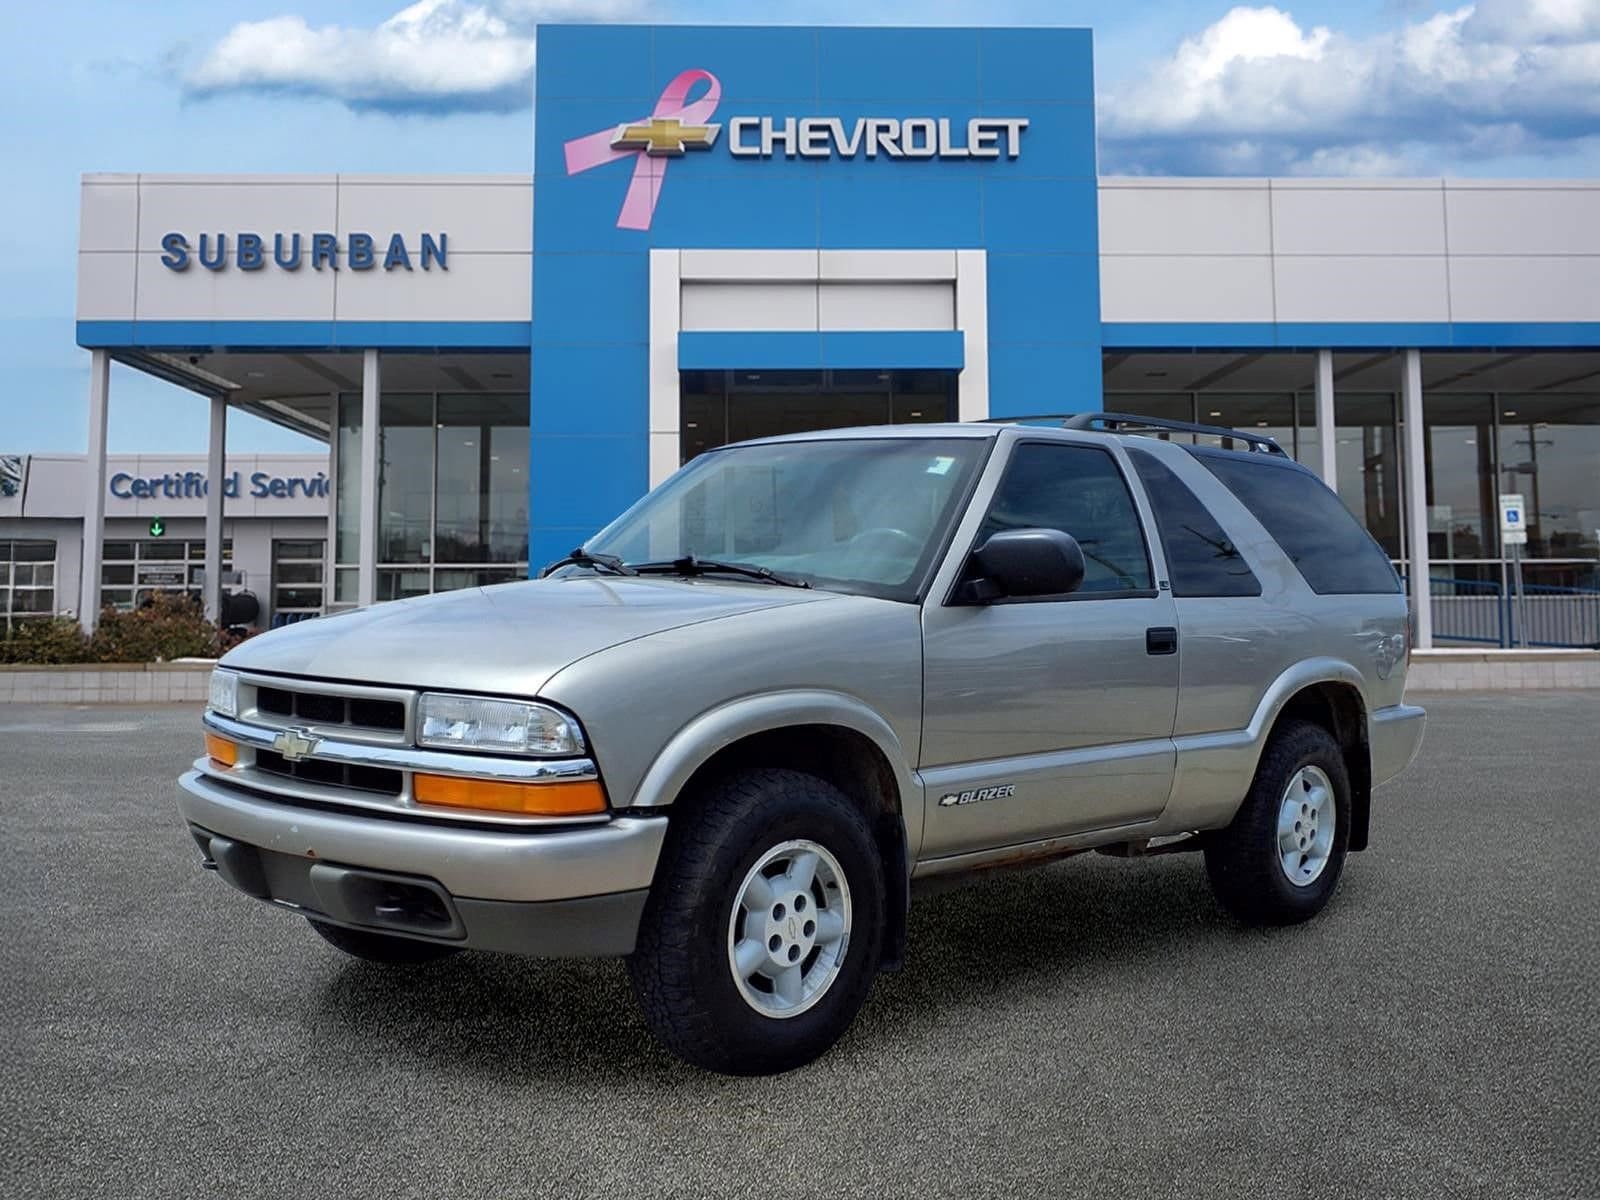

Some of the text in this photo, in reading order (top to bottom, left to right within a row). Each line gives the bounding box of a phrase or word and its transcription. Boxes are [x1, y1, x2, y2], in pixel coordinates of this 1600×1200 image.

[728, 116, 1030, 159] CHEVROLET
[161, 232, 448, 271] SUBURBAN
[110, 472, 240, 499] Certifid
[957, 783, 1017, 805] BLAZER
